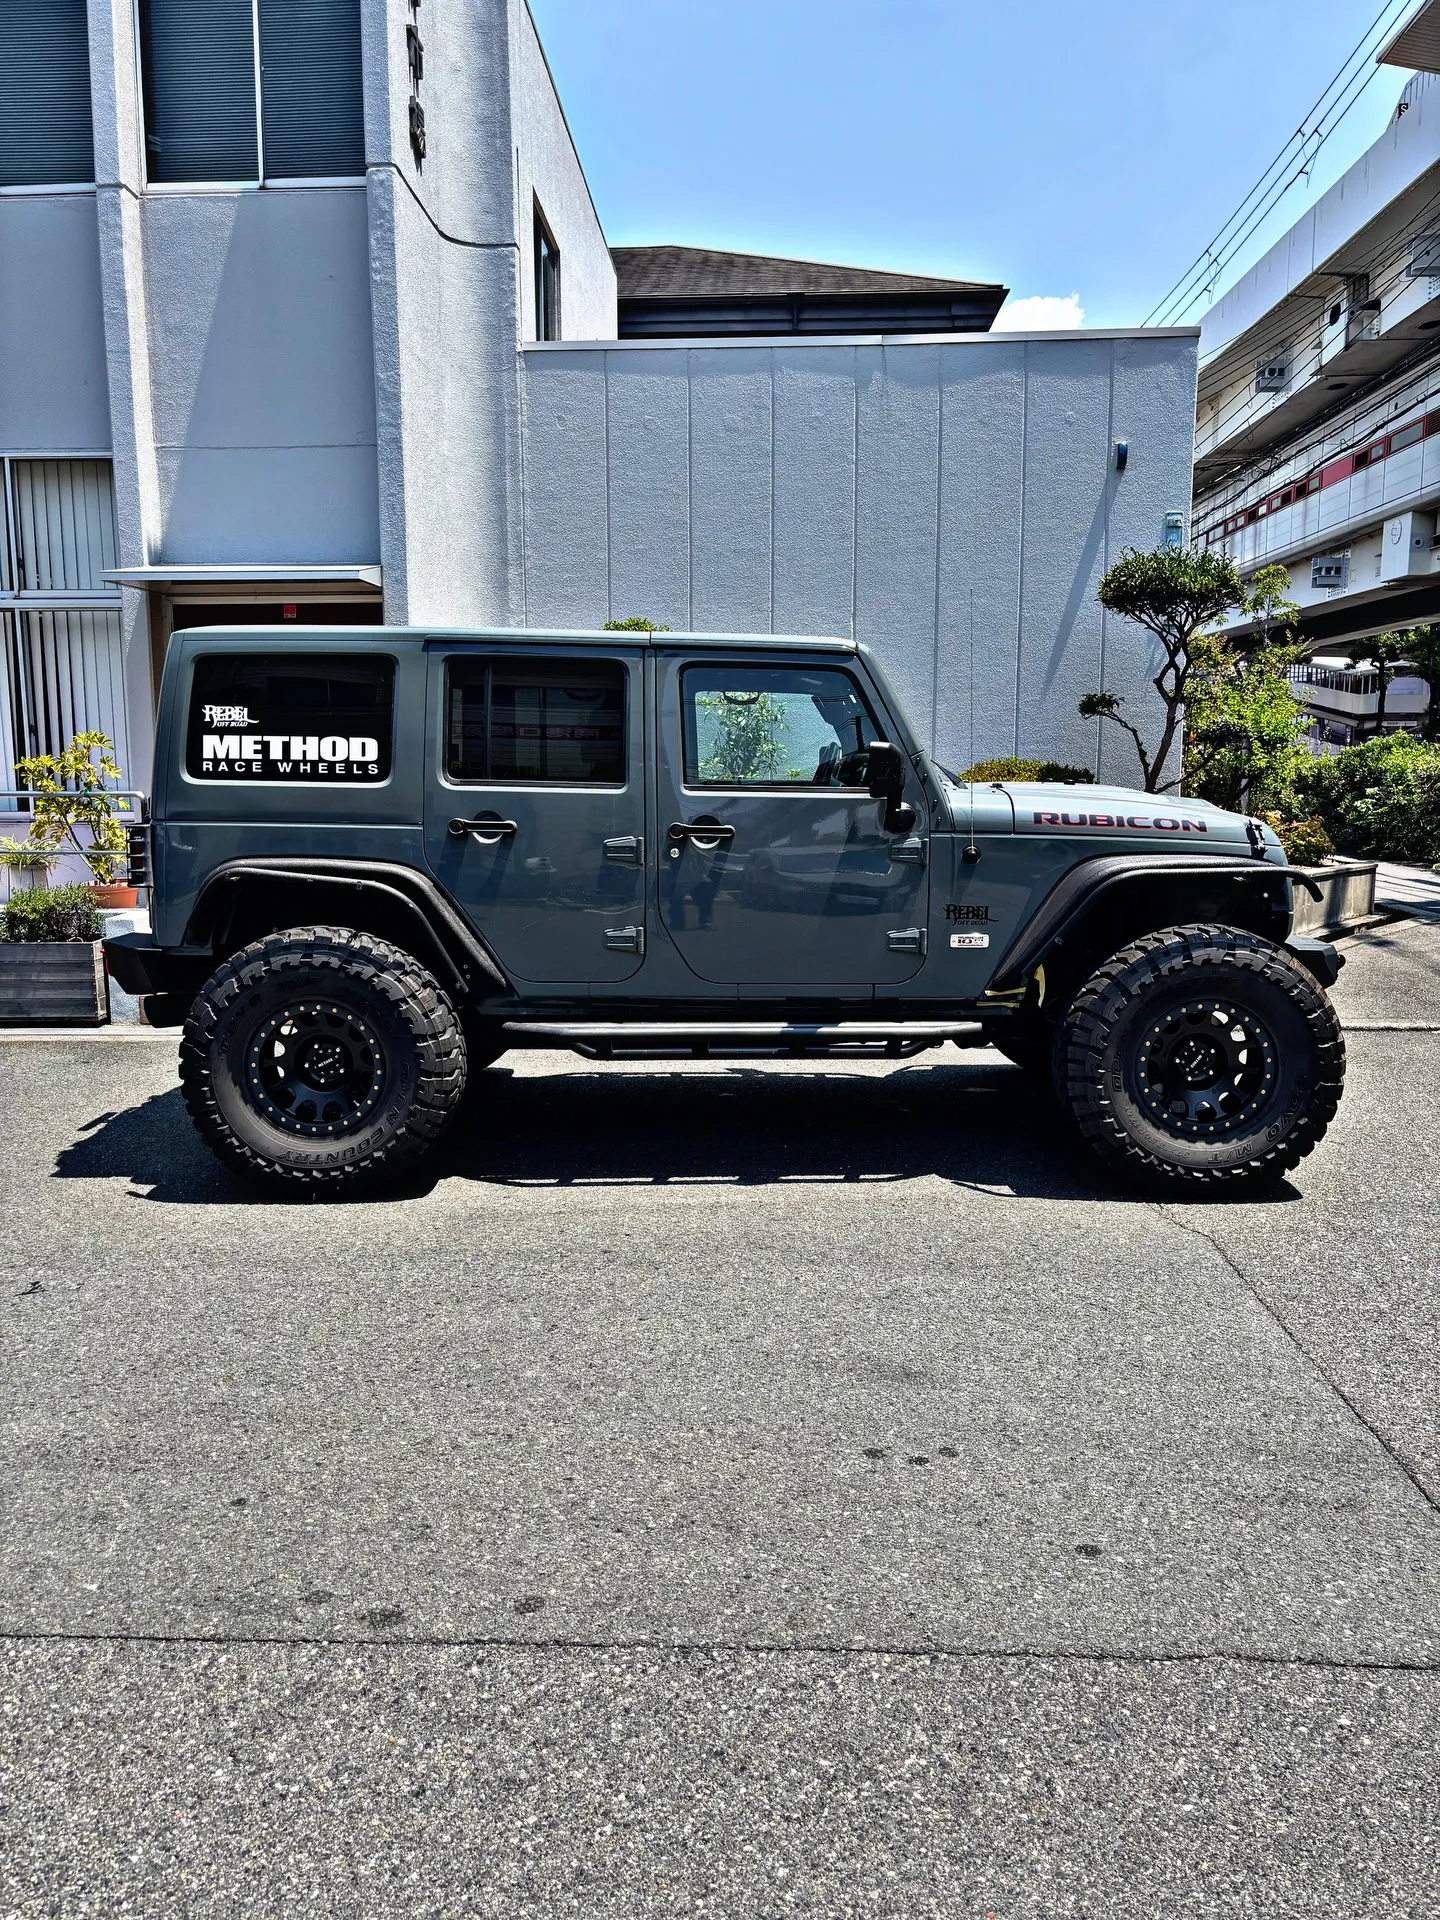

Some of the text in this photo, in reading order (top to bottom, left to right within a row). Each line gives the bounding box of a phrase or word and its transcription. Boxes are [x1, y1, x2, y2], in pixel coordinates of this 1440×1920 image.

[201, 704, 260, 728] REBEL
[202, 734, 379, 762] METHOD
[202, 761, 379, 774] RACE WHEELS
[1032, 811, 1208, 833] RUBICON
[943, 903, 999, 926] REBEL
[276, 1127, 385, 1164] COUNTRY
[1208, 1143, 1253, 1165] M/T
